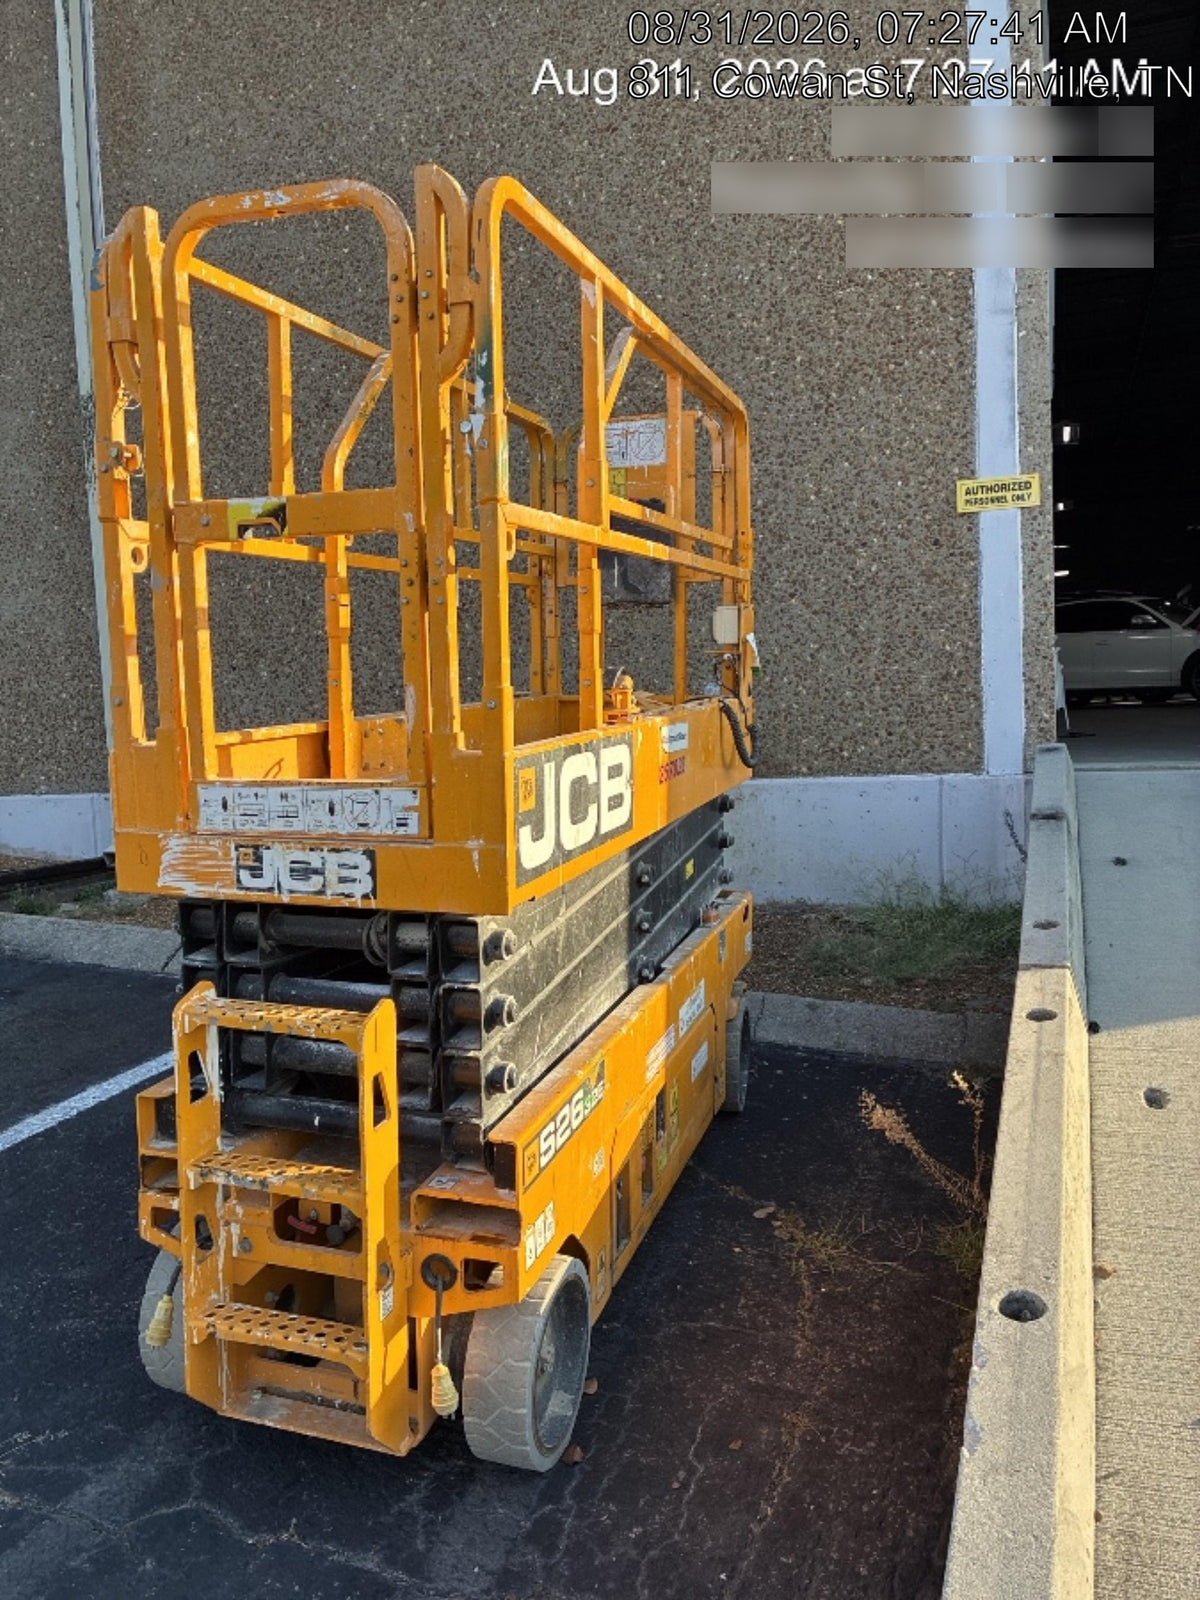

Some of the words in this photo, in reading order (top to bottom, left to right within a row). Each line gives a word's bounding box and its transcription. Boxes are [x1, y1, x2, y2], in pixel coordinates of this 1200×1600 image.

[965, 481, 1032, 496] AUTHORIZED
[965, 495, 1008, 506] PERSONNEL
[1011, 492, 1032, 502] ONLY
[518, 743, 633, 871] JCB
[239, 846, 374, 897] JCB
